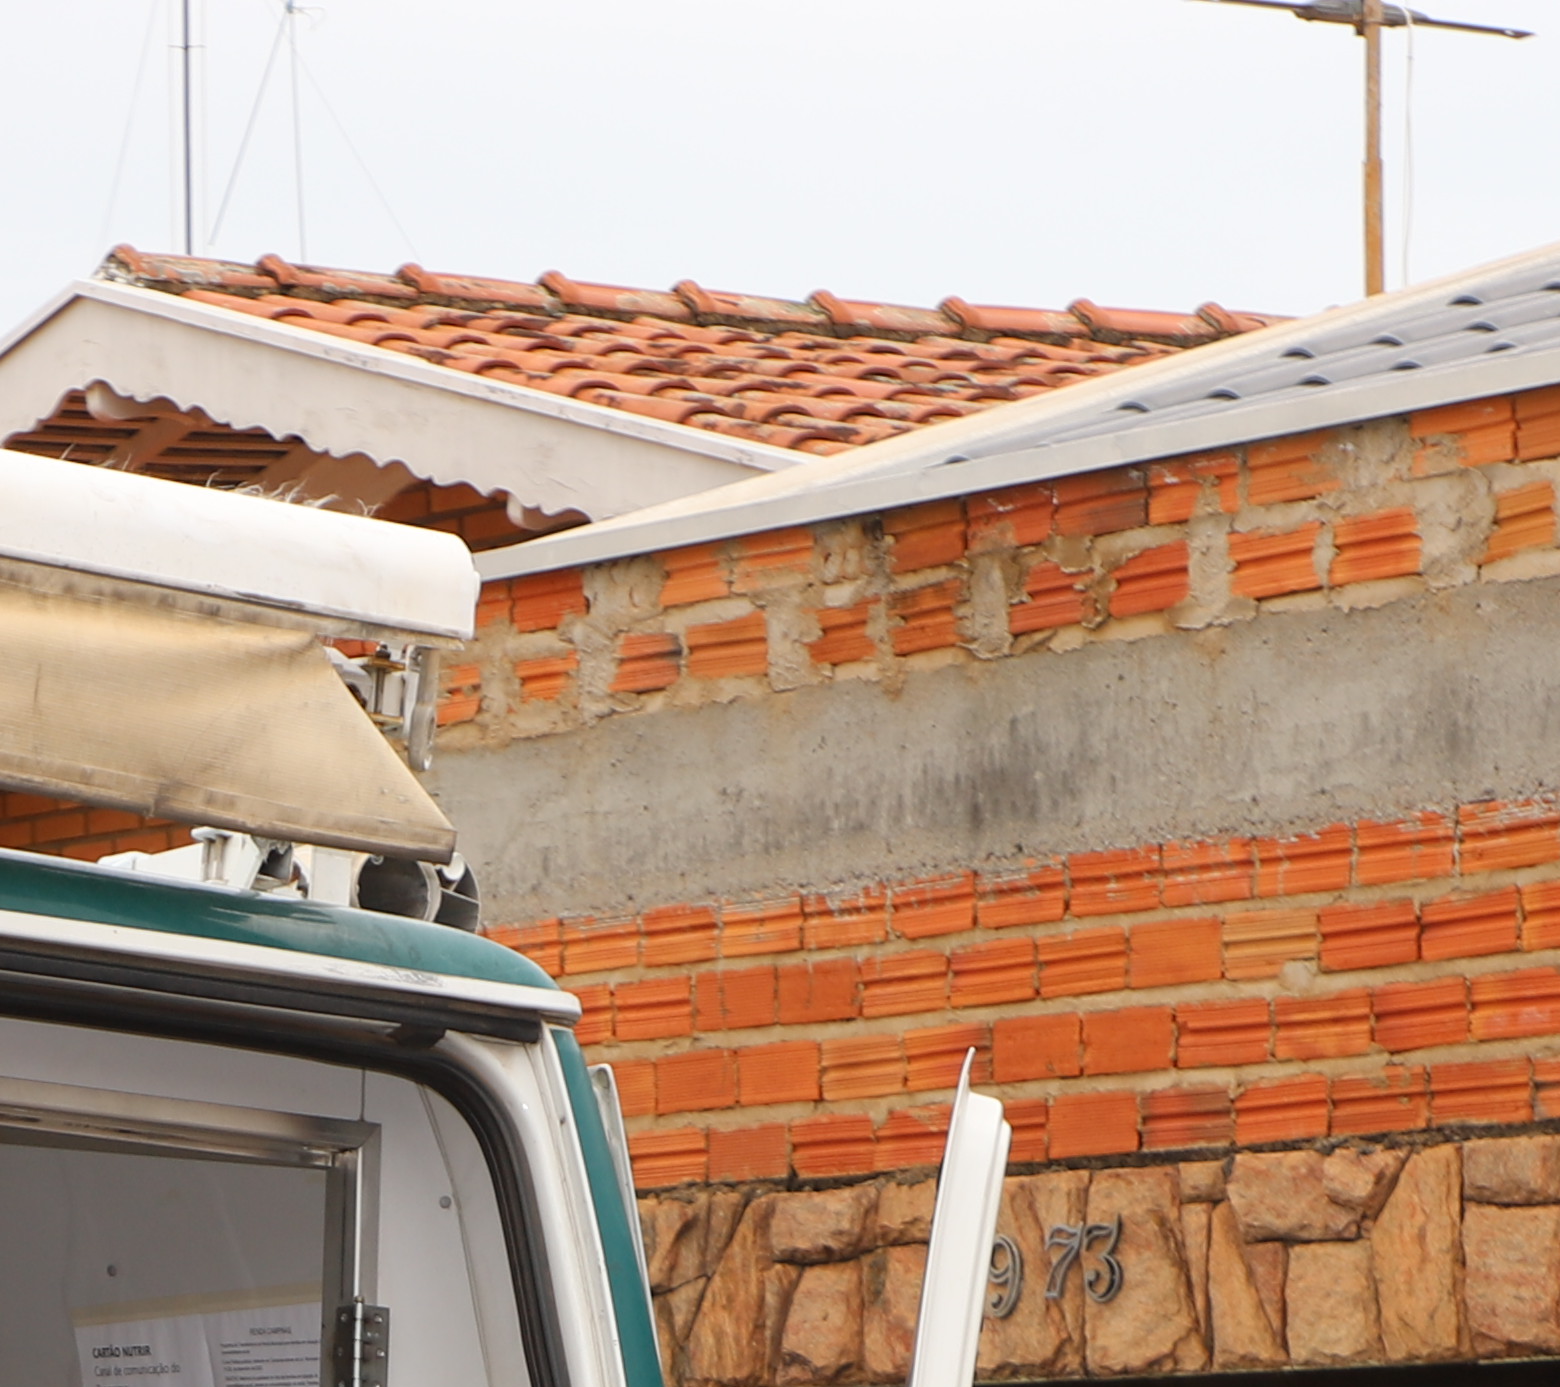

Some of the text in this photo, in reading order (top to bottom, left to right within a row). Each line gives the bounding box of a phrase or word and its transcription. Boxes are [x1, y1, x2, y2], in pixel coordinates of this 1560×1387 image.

[92, 1344, 152, 1358] CARTÃO NUTRIR
[94, 1362, 181, 1377] Canal de comunicação do
